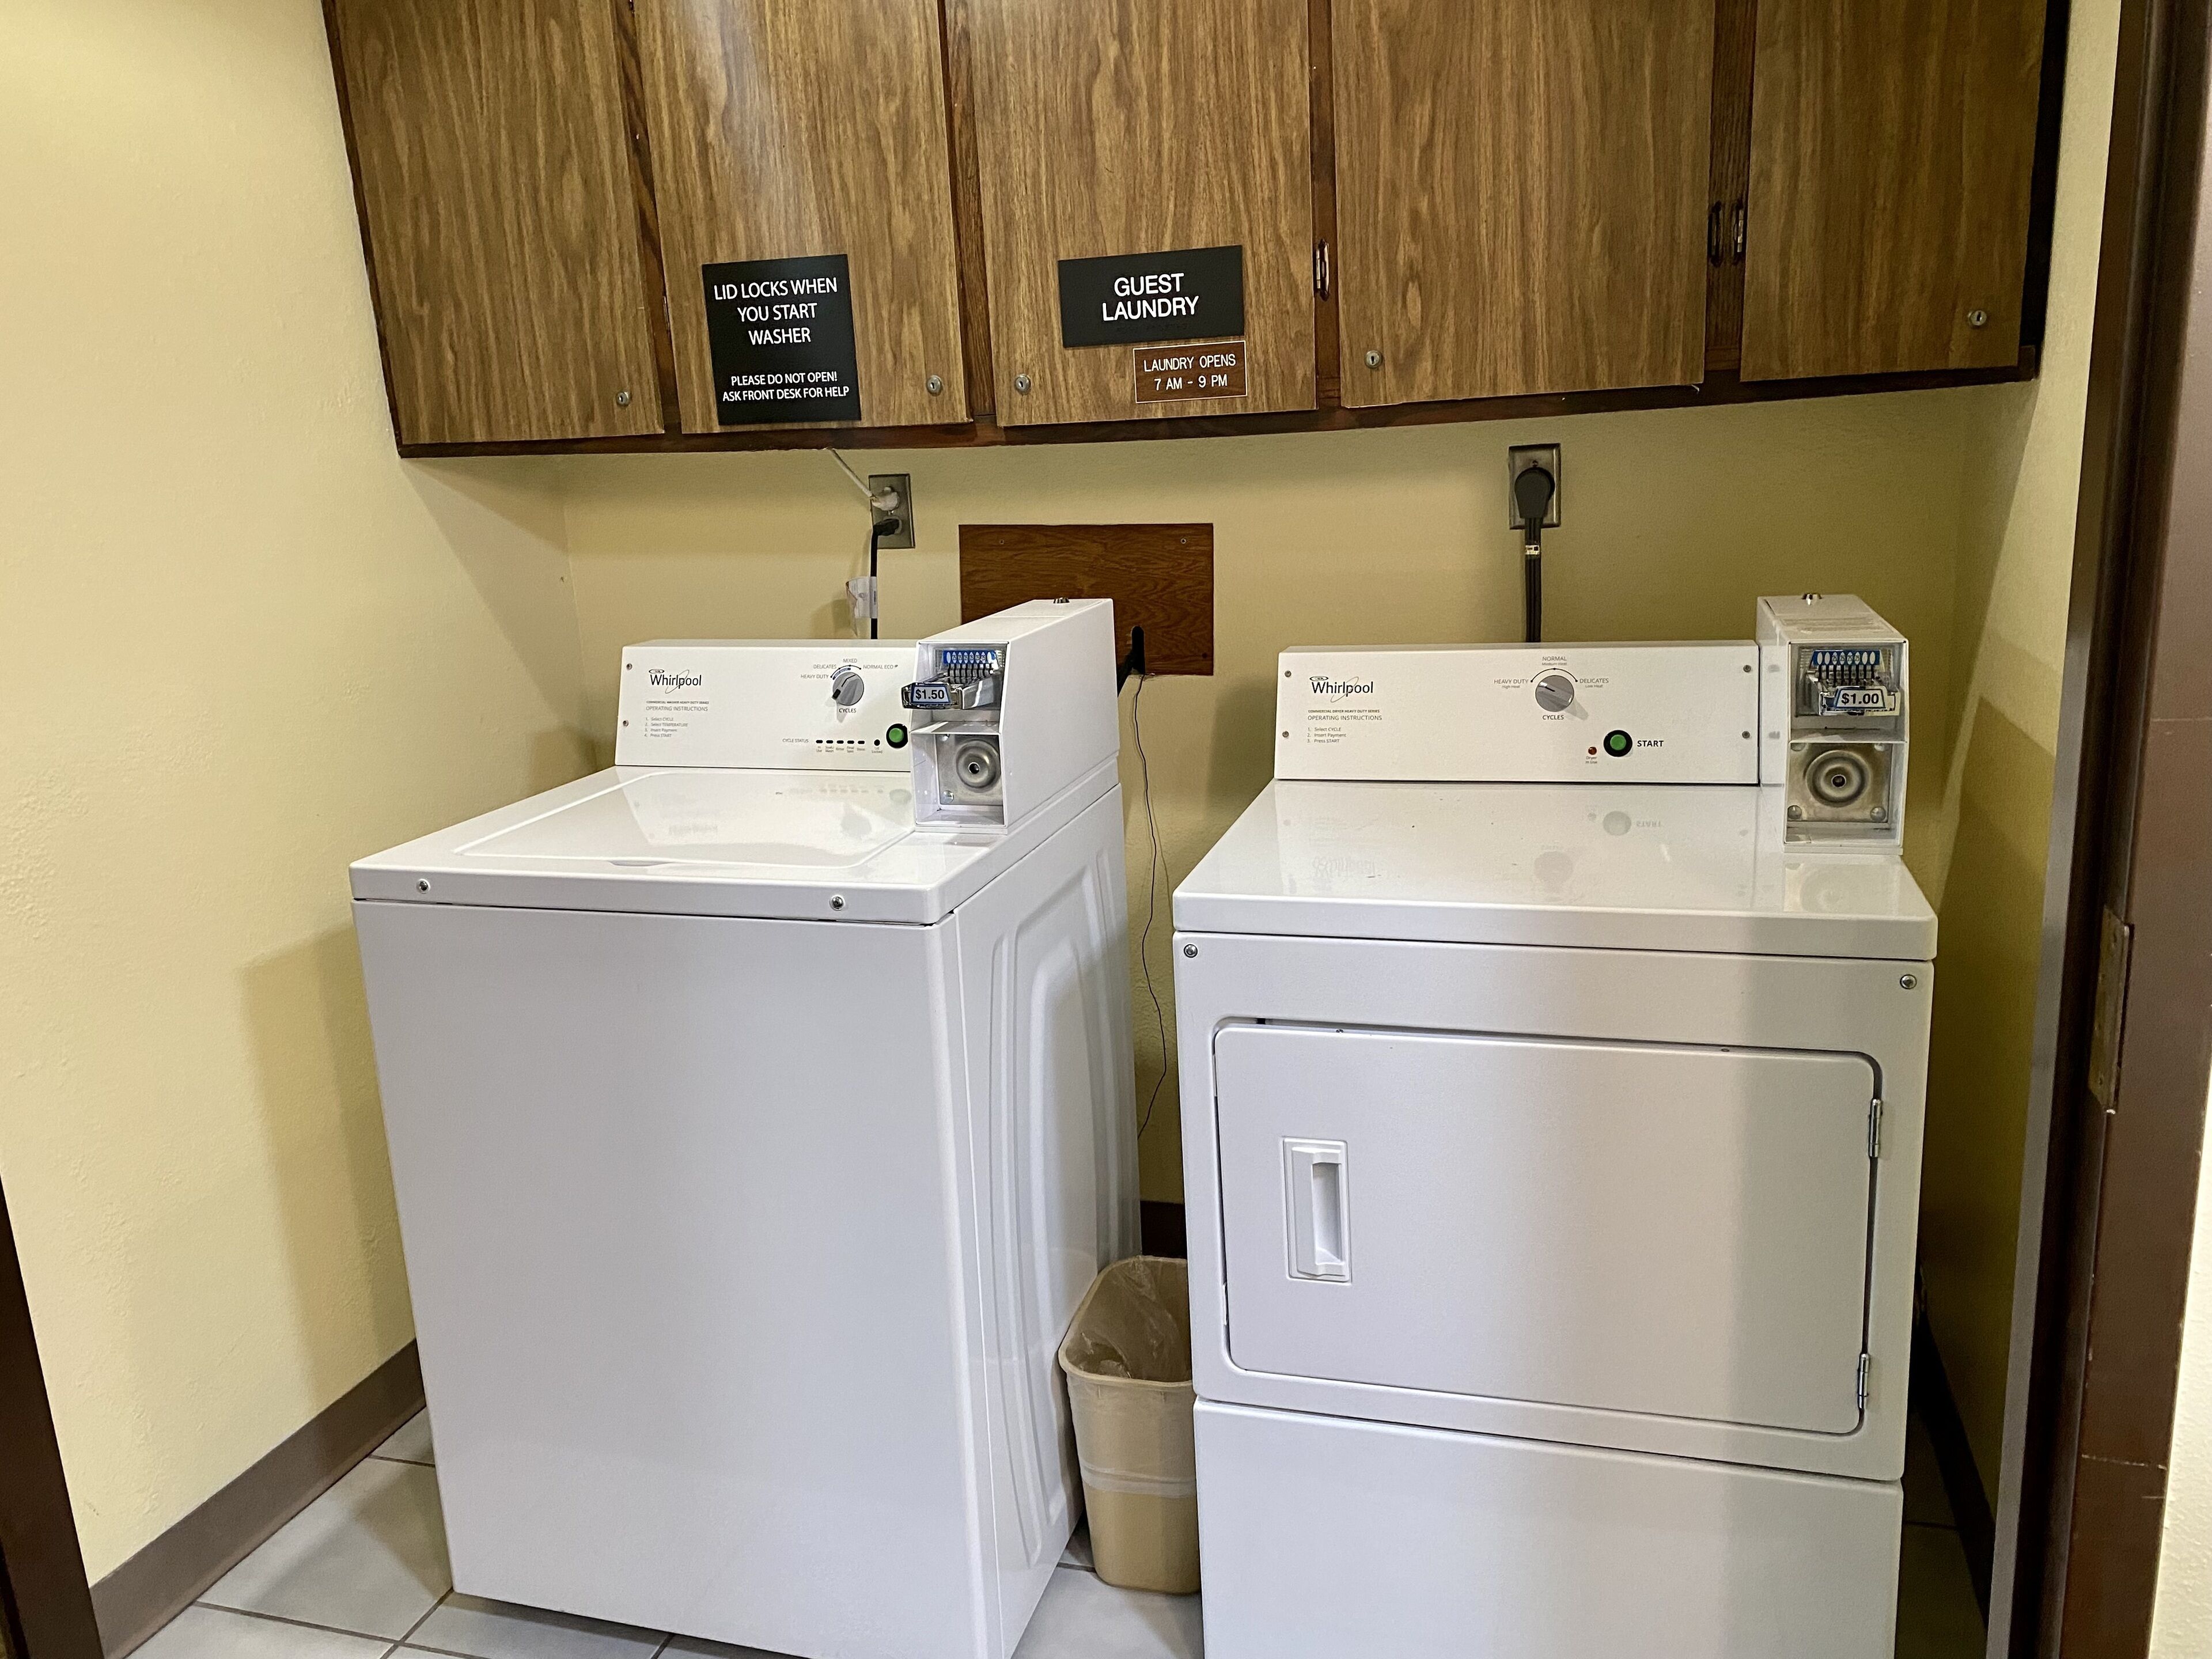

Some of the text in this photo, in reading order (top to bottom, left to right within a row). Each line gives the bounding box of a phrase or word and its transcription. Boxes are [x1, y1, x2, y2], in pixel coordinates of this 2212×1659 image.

[714, 277, 838, 300] LID LOCKS WHEN
[1114, 273, 1184, 297] GUEST
[737, 302, 818, 322] YOU START
[1102, 296, 1199, 321] LAUNDRY
[748, 327, 811, 346] WASHER
[1143, 354, 1236, 372] LAUNDRY OPENS
[731, 371, 838, 386] PLEASE DO NOT OPEN!
[1154, 378, 1162, 391] 7
[1166, 377, 1183, 390] AM
[1198, 375, 1206, 388] 9
[1211, 374, 1228, 387] PM
[722, 385, 850, 402] ASK FRONT DESK FOR HELP
[650, 674, 702, 689] Whirlpool
[1311, 681, 1373, 697] Whirlpool
[915, 688, 945, 700] $1.50
[1841, 692, 1879, 705] $1.00
